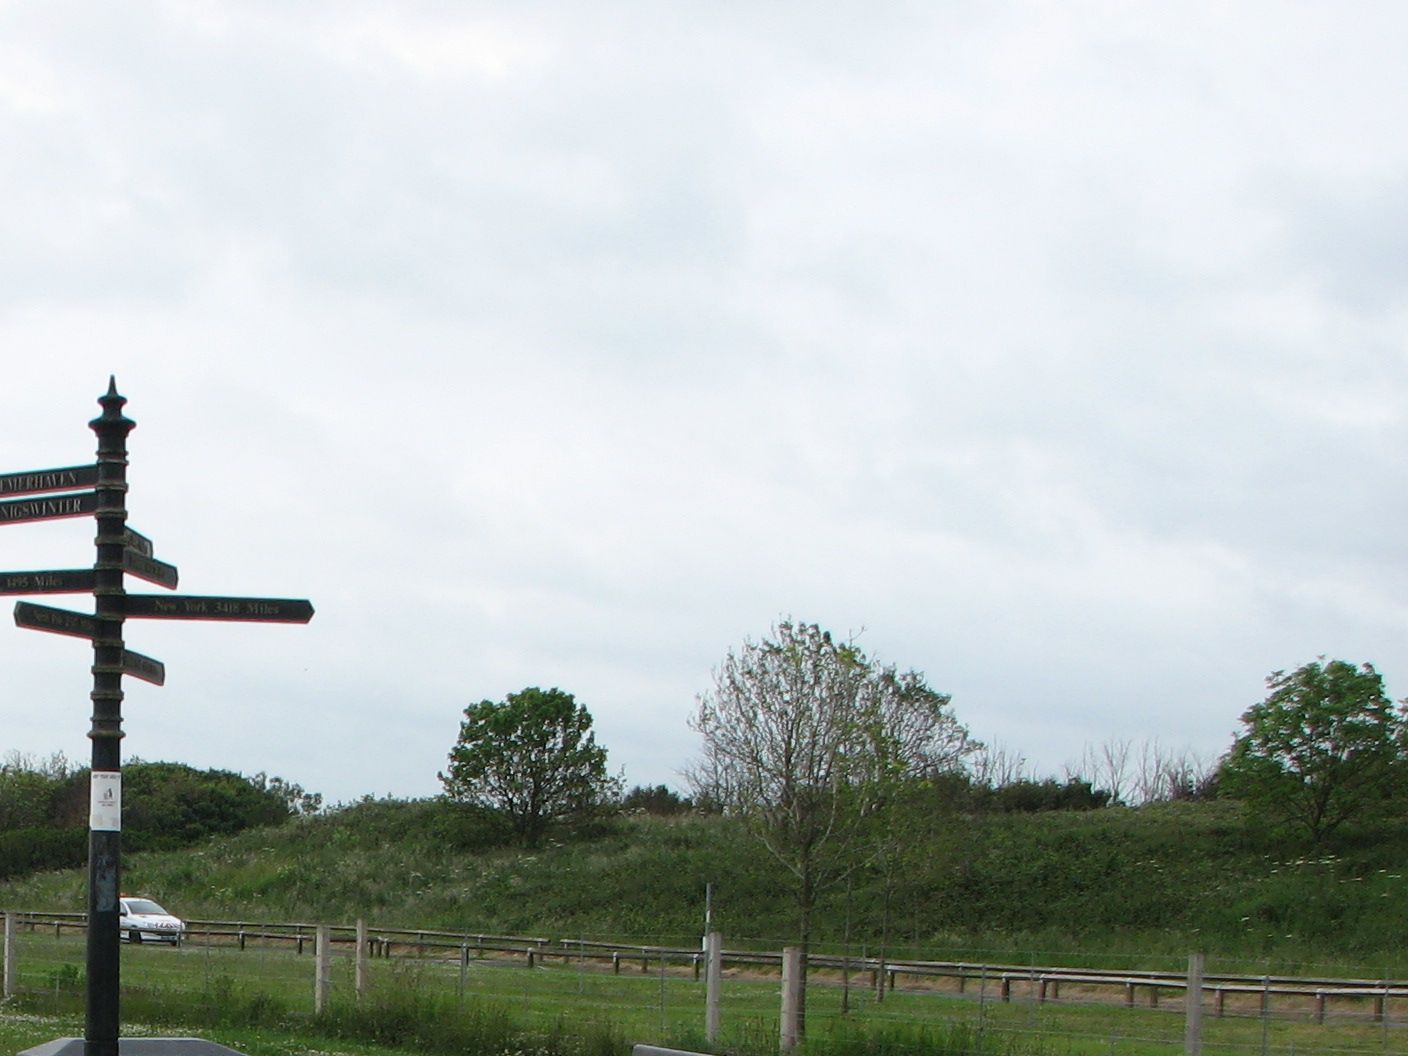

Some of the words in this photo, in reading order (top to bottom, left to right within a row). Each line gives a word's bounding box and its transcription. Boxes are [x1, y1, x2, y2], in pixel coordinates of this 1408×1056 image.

[153, 600, 177, 612] New
[184, 600, 208, 613] York
[247, 602, 280, 615] Miles
